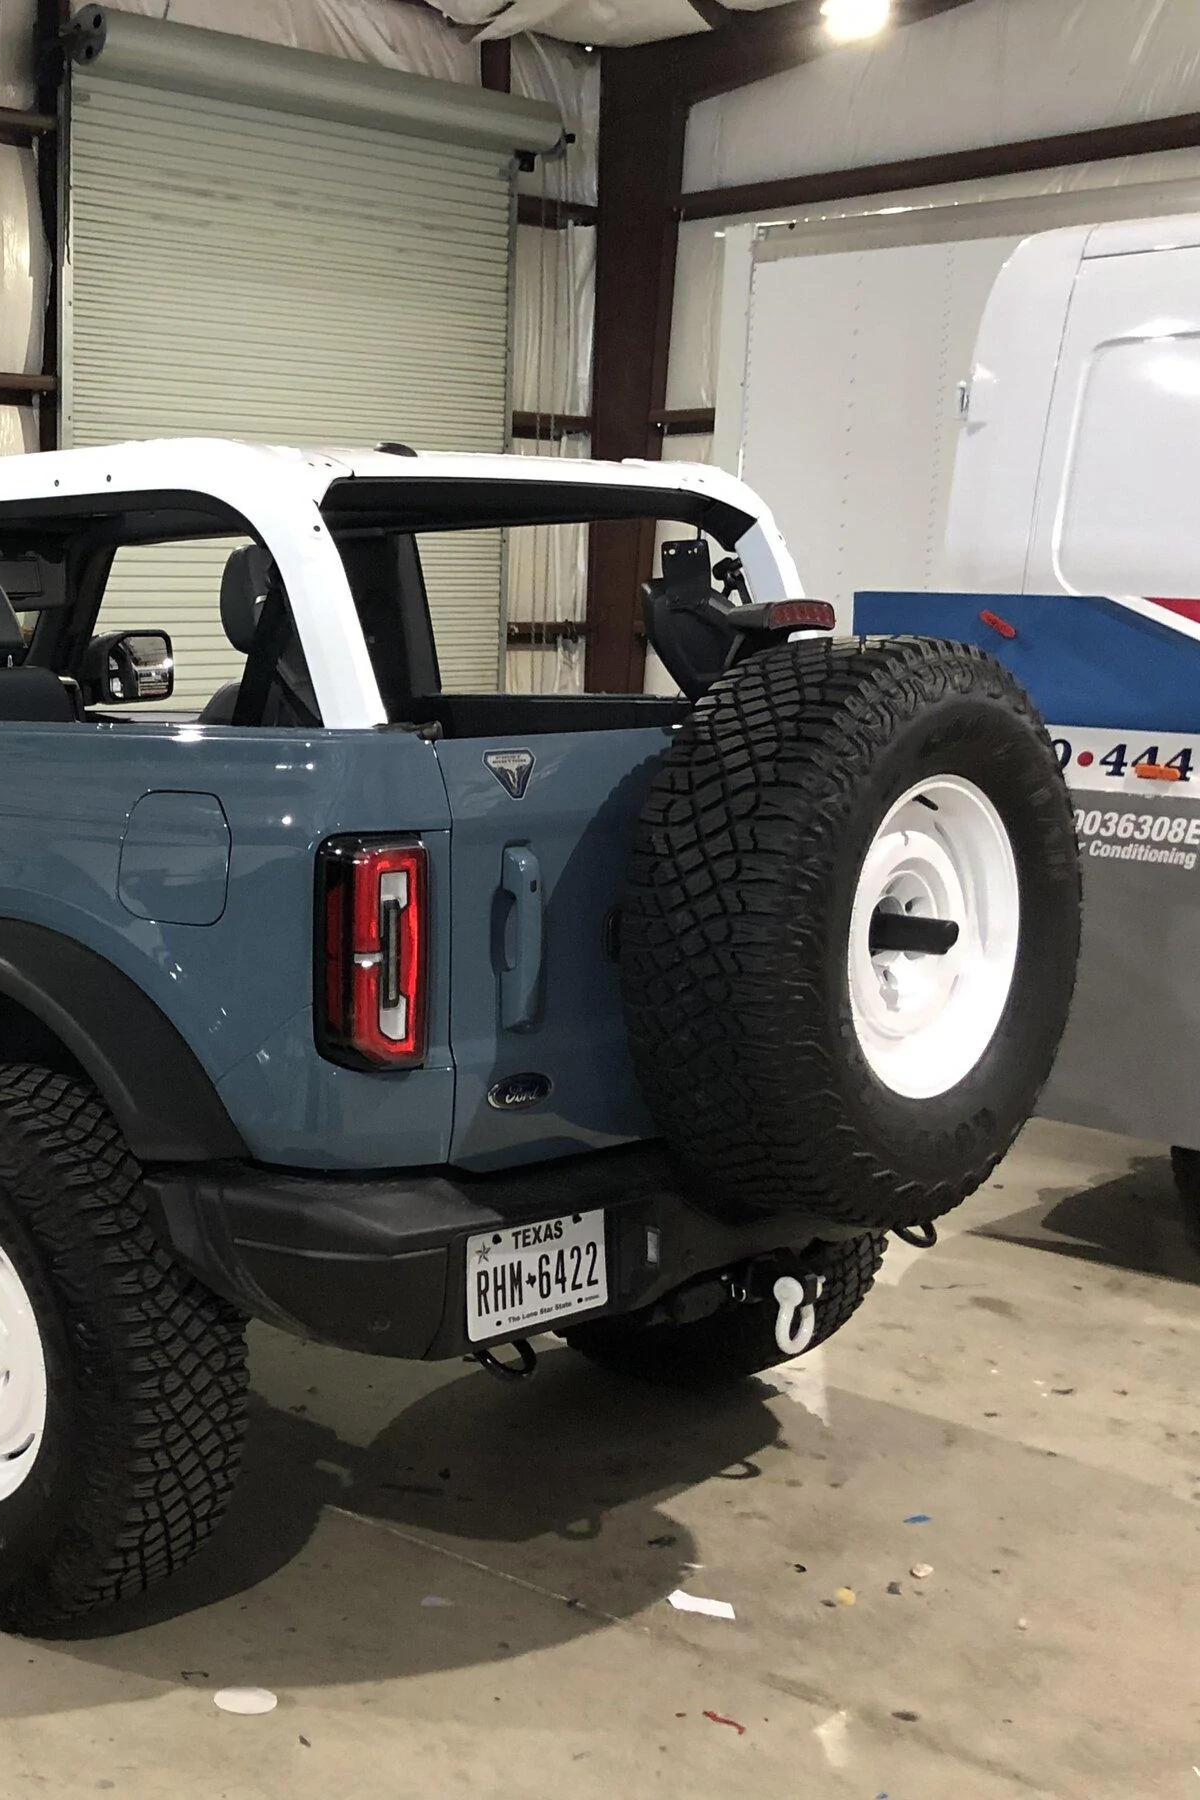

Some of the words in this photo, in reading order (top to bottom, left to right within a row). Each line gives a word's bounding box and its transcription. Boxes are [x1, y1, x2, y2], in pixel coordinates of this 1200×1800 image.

[1089, 840, 1197, 870] Conditioning
[511, 1220, 564, 1250] TEXAS
[508, 1315, 521, 1323] The
[522, 1310, 538, 1320] Lone
[540, 1306, 553, 1314] Star
[555, 1301, 572, 1310] State
